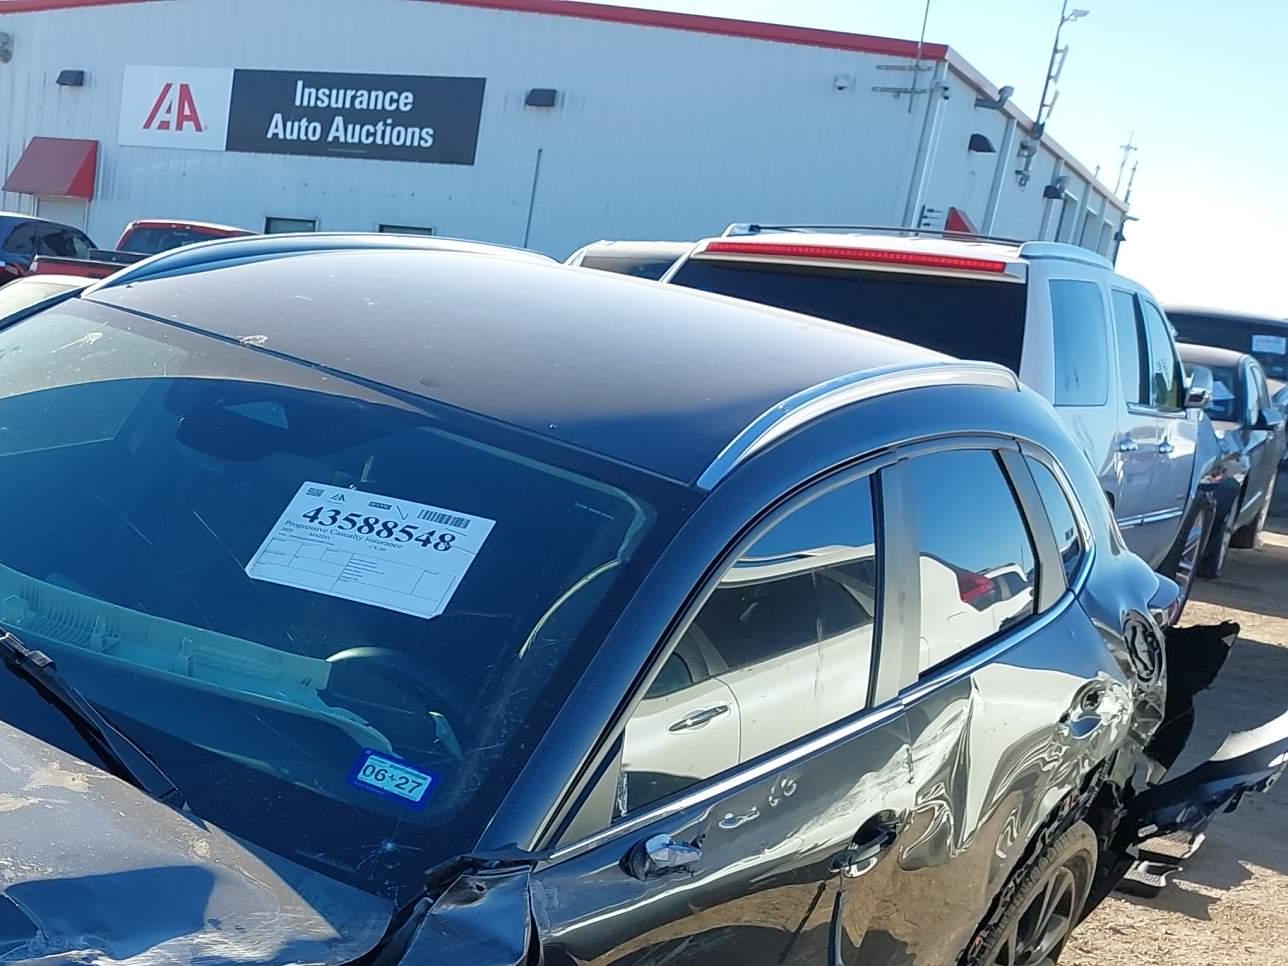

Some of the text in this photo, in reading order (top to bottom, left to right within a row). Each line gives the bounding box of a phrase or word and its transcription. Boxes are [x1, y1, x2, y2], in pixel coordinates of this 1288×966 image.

[294, 79, 414, 112] Insurance
[266, 113, 435, 148] Auto Auctions
[284, 519, 329, 535] Progressive
[329, 528, 363, 542] Casualty
[364, 536, 403, 550] Insurance
[302, 505, 457, 552] 43588548
